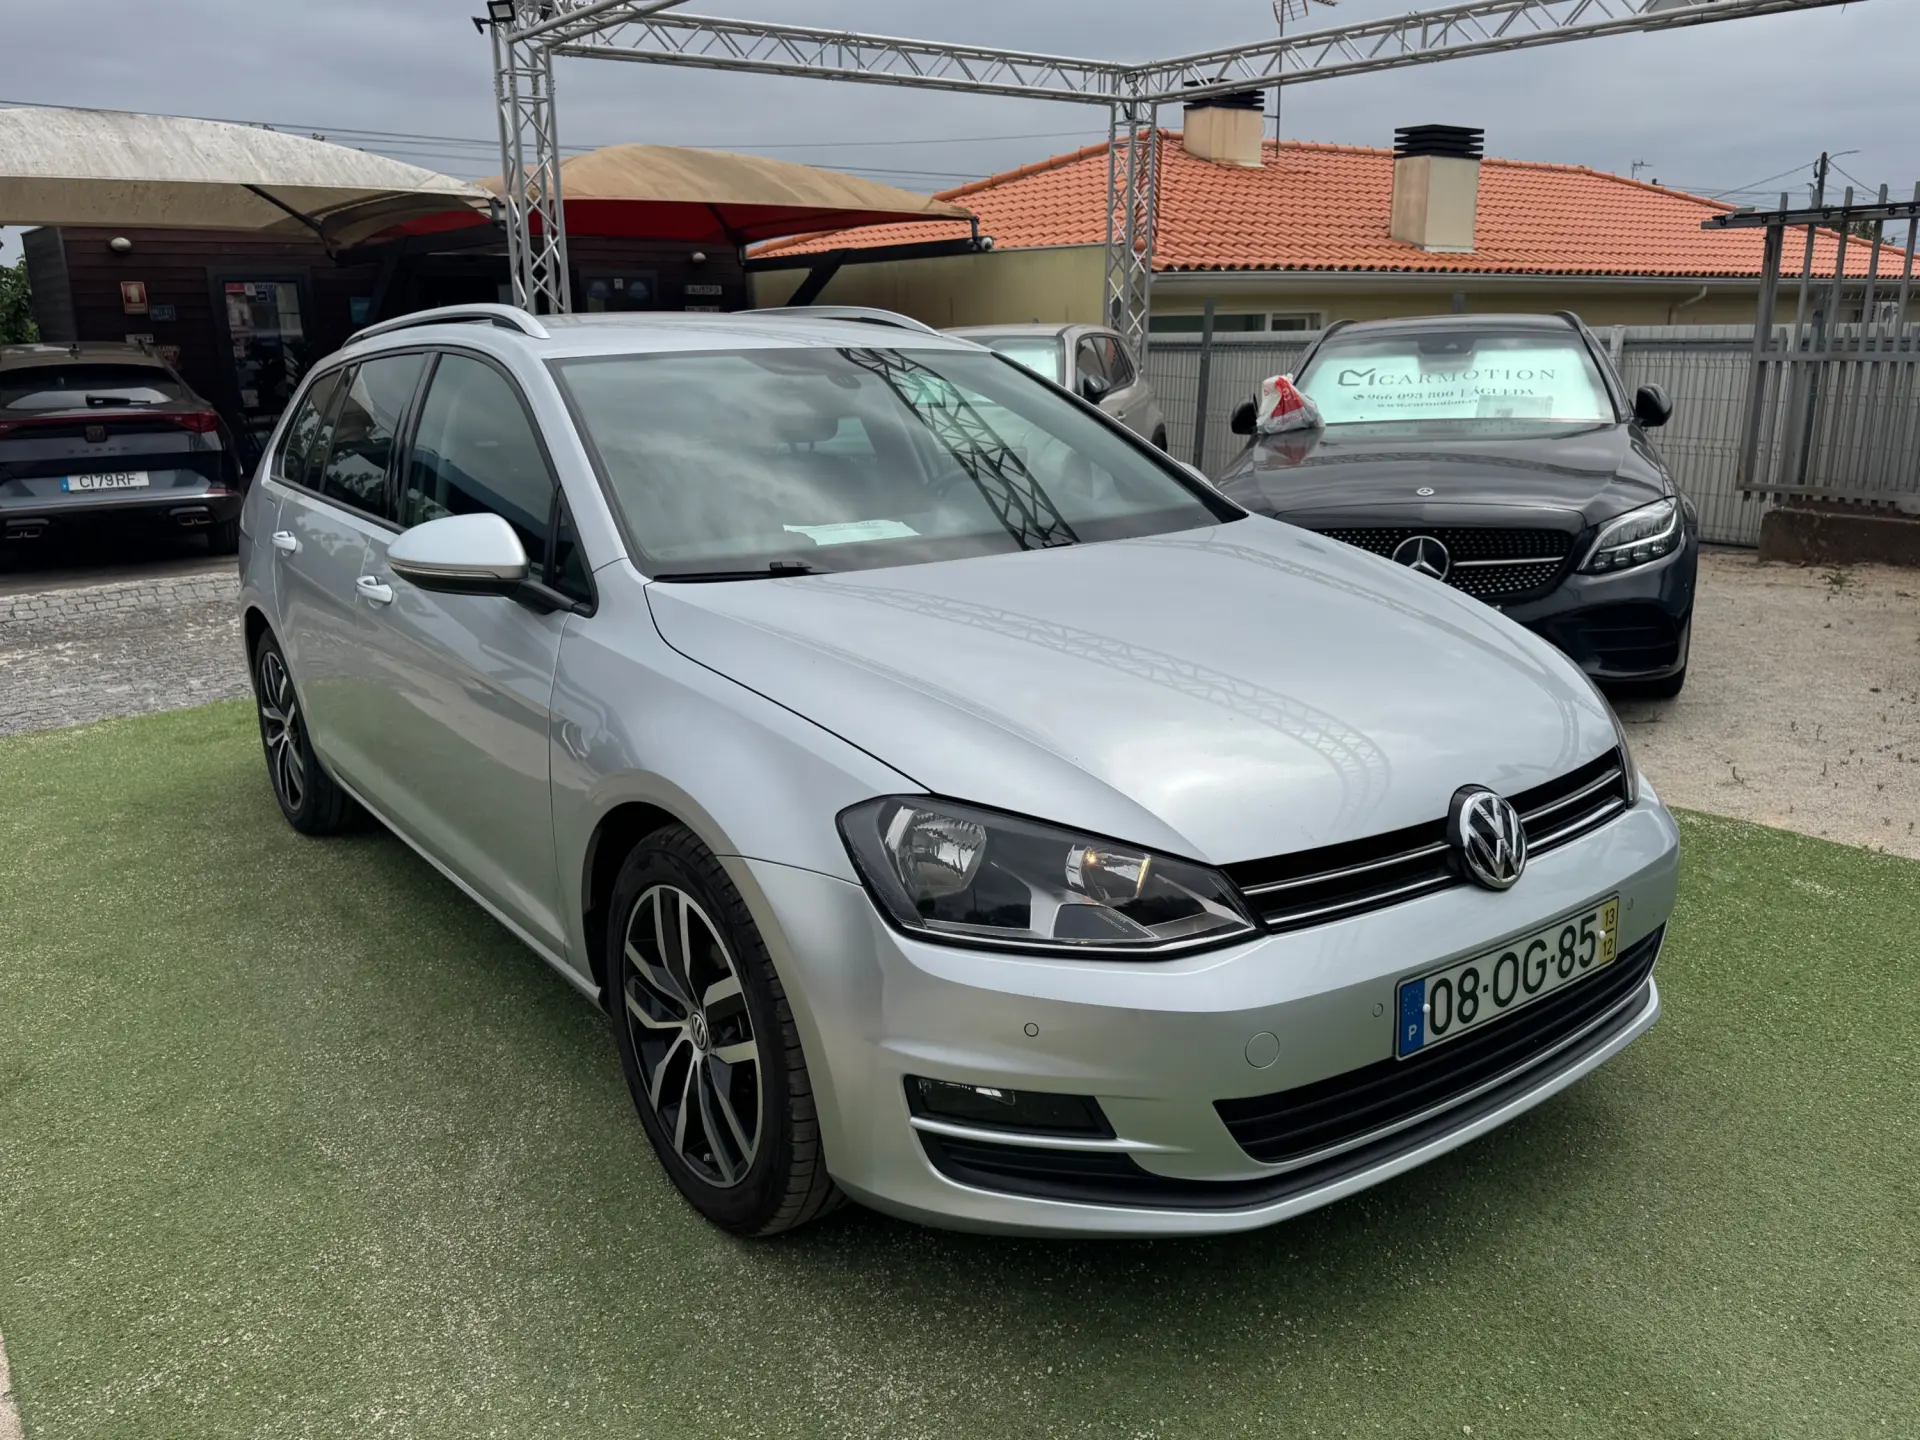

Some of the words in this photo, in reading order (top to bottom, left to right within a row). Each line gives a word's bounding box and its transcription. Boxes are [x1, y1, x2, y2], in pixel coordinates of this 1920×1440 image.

[1379, 369, 1556, 385] CARMOTION
[1604, 908, 1615, 926] 13
[1603, 938, 1613, 957] 12
[1408, 1024, 1417, 1041] P
